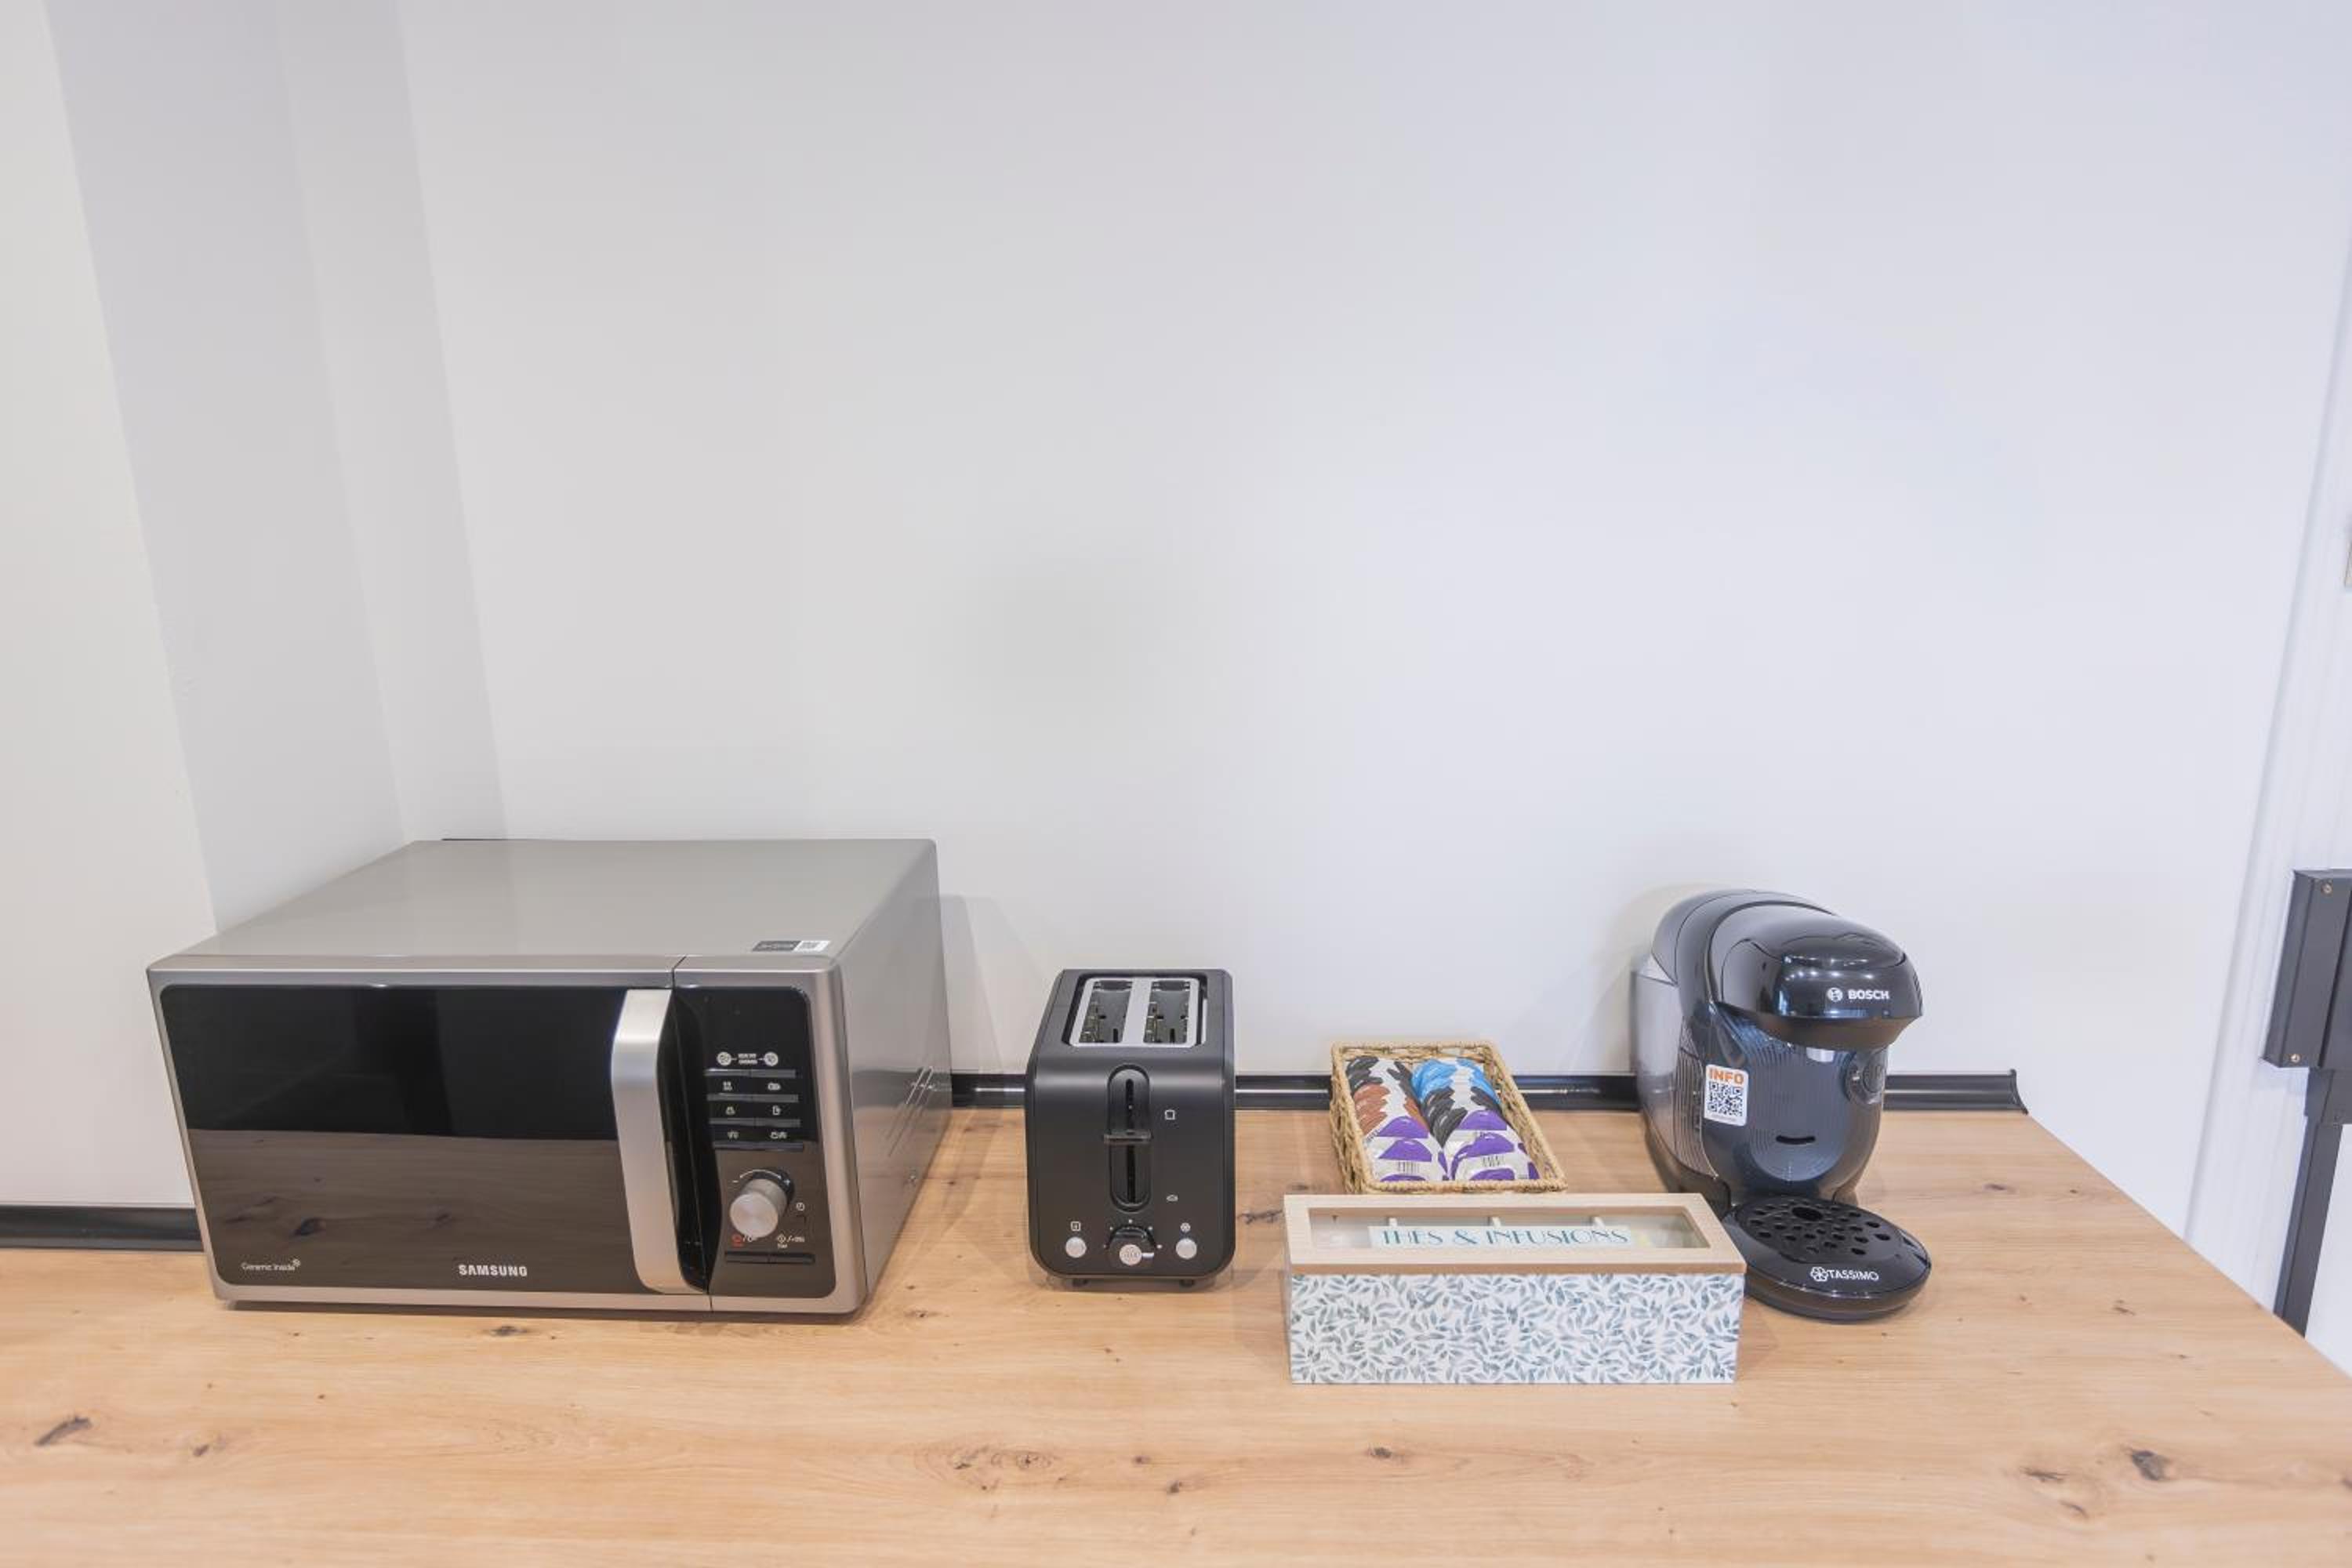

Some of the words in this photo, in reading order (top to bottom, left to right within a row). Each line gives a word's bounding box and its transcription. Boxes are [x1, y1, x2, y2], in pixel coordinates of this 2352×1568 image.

[1848, 989, 1890, 1000] BOSCH
[1708, 1068, 1744, 1085] INFO
[1454, 1229, 1479, 1245] &
[1486, 1229, 1628, 1245] INFUSIONS
[459, 1264, 528, 1277] SAMSUNG
[1827, 1269, 1879, 1280] TASSIMO
